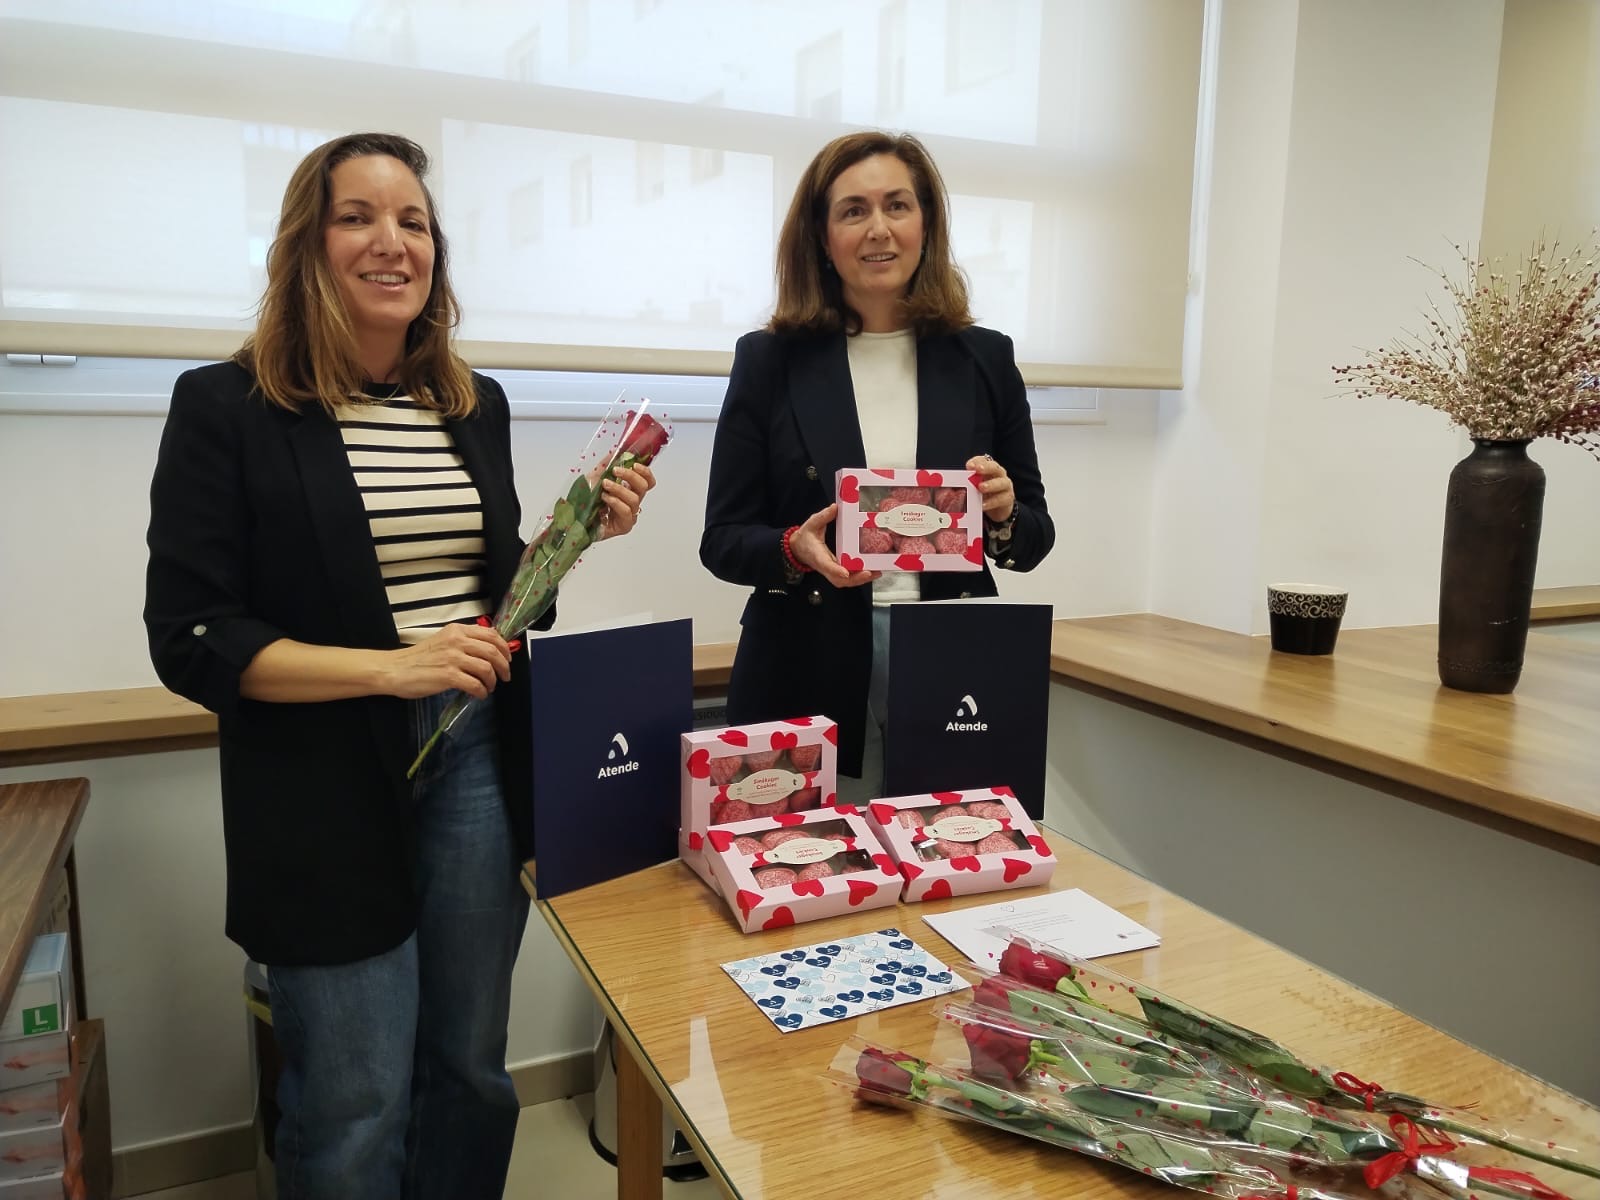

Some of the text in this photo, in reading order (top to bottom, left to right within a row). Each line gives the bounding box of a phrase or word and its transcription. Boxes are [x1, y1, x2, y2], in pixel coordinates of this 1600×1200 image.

[945, 721, 988, 732] Atende
[598, 760, 639, 779] Atende
[34, 1009, 48, 1026] L
